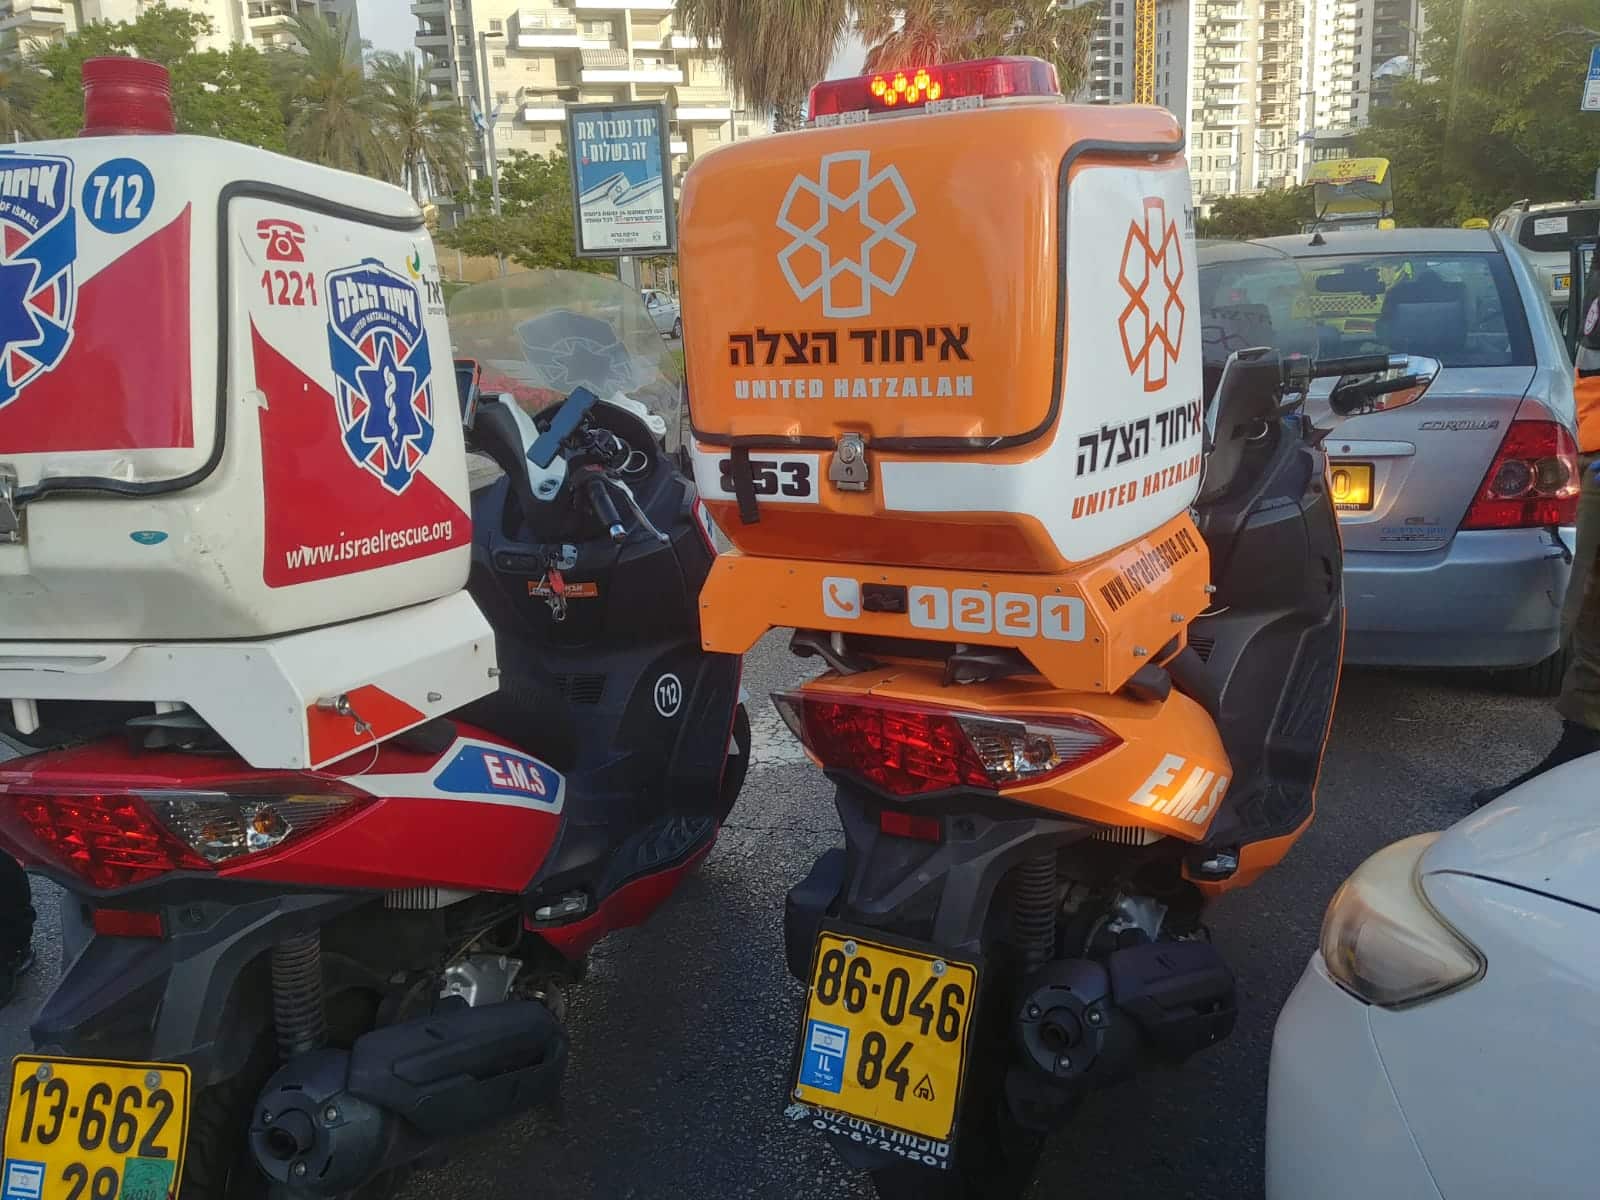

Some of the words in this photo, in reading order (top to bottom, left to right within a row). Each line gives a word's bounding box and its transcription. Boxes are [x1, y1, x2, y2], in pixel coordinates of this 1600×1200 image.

[577, 121, 596, 140] את
[596, 119, 632, 140] נעבור
[634, 118, 656, 137] יחד
[631, 142, 647, 161] זה
[0, 164, 60, 209] איחו
[93, 173, 145, 219] 712
[12, 204, 40, 230] ISRAEL
[261, 269, 318, 306] 1221
[335, 276, 380, 324] הצלה
[379, 285, 419, 329] איחוד
[728, 328, 837, 366] הצלה
[850, 326, 970, 363] איחוד
[734, 378, 824, 399] UNITED
[833, 375, 974, 398] HATZALAH
[1155, 399, 1201, 449] איחוד
[1417, 419, 1500, 432] COROLLA
[1075, 417, 1151, 476] הצלה
[718, 458, 811, 497] 853
[1071, 480, 1138, 520] UNITED
[1142, 453, 1201, 498] HATZALAH
[285, 519, 453, 569] www.israelrescue.org
[917, 593, 1072, 633] 1221
[659, 682, 678, 708] 712
[483, 753, 548, 796] E.M.S
[817, 1054, 831, 1073] IL
[856, 1030, 915, 1102] 84
